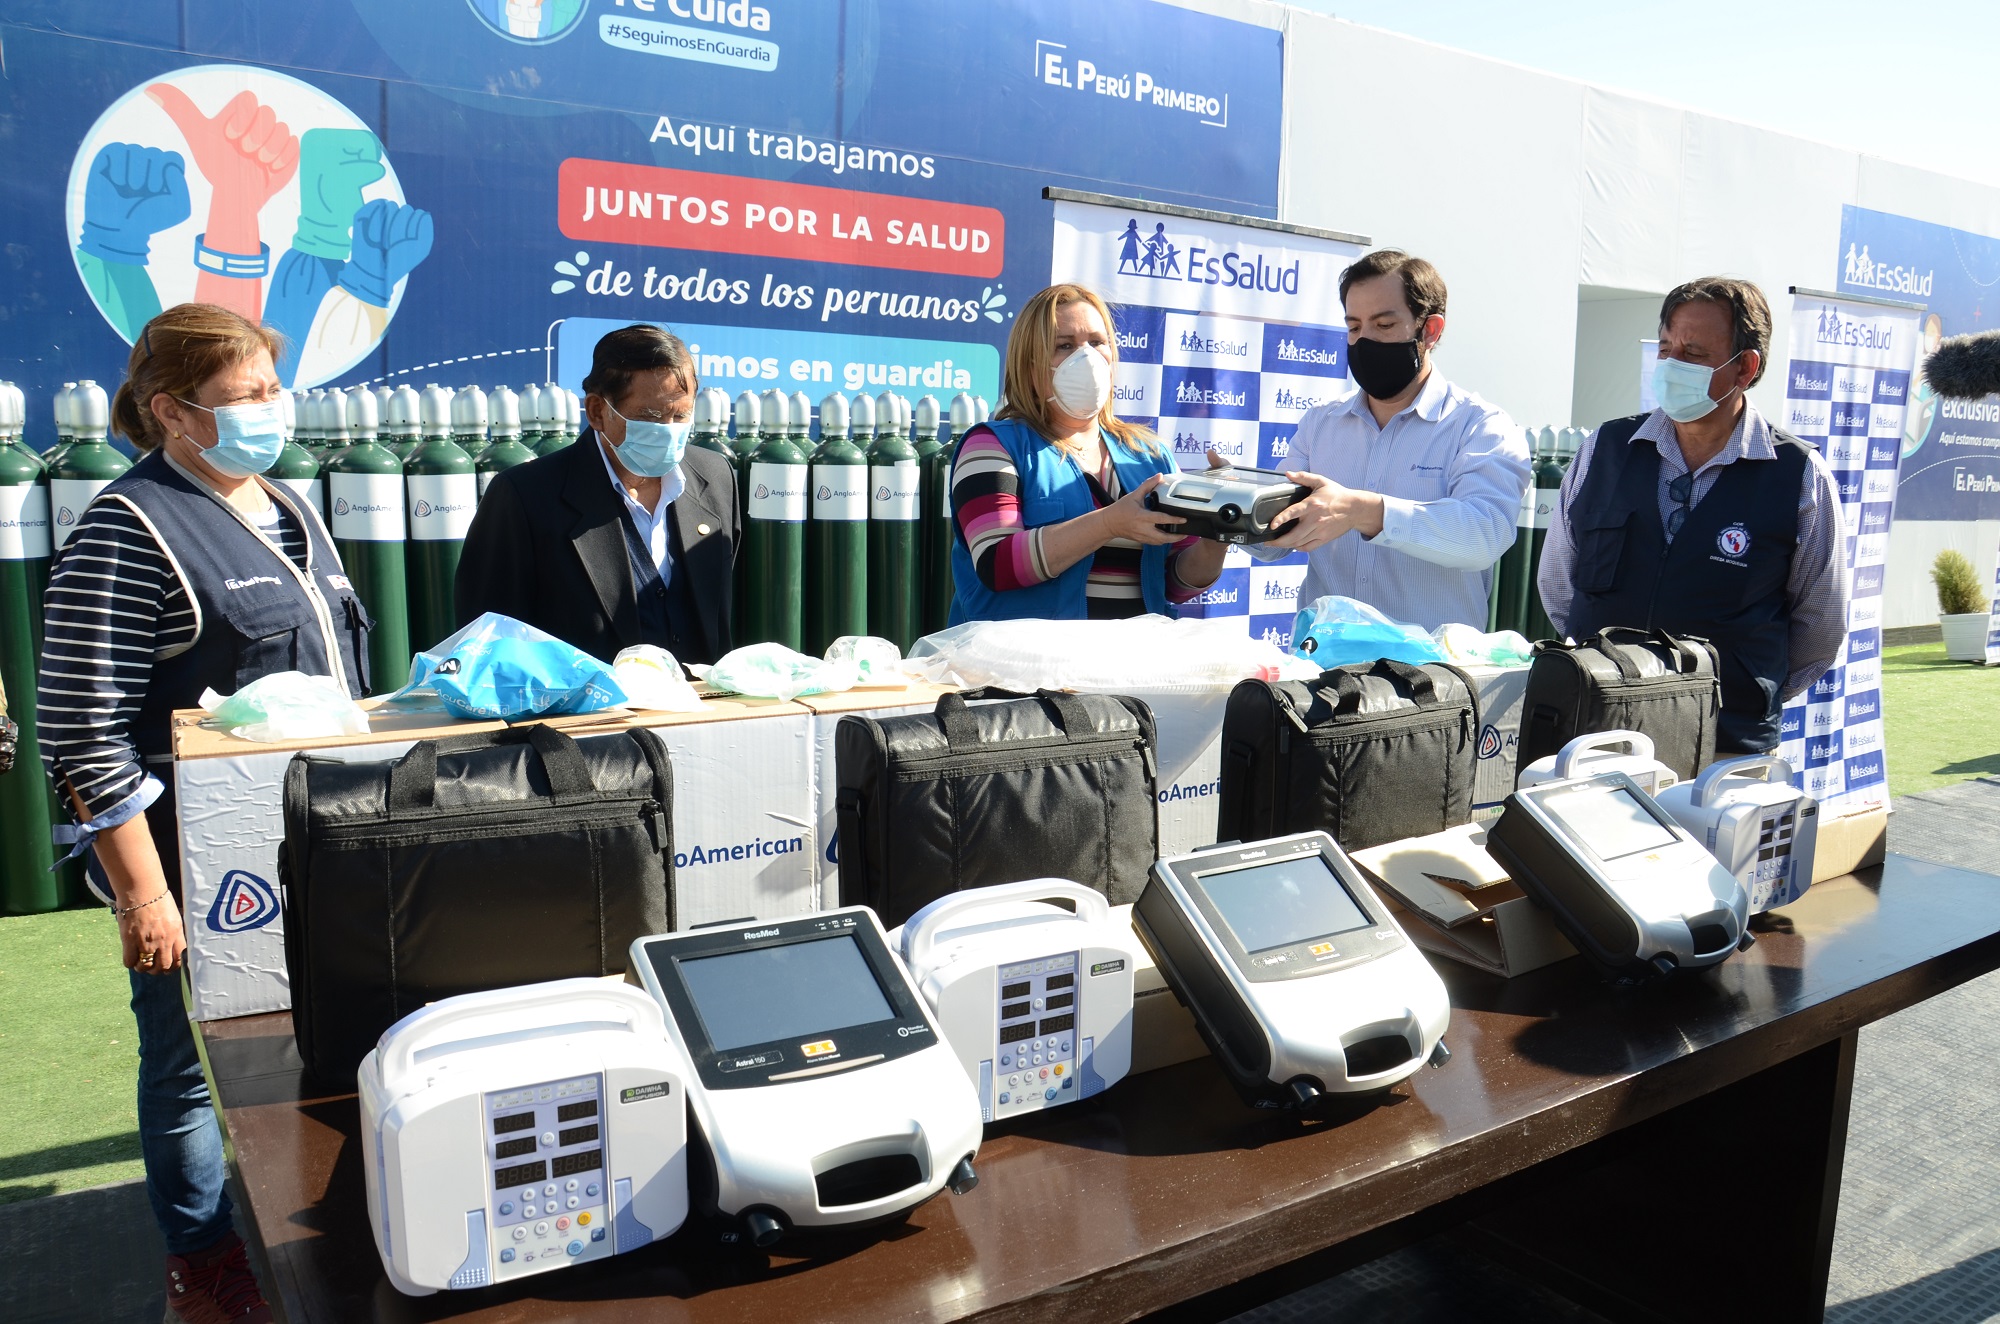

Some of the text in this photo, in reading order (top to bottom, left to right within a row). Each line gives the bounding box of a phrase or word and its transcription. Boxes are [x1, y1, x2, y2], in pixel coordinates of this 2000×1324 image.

[607, 24, 770, 61] #SeguimosEnGuardia
[649, 116, 936, 179] Aquí trabajamos
[583, 186, 990, 254] JUNTOS POR LA SALUD
[1187, 247, 1300, 295] EsSalud
[1876, 262, 1934, 297] EsSalud
[586, 260, 980, 322] de todos los peruanos
[1114, 331, 1148, 349] Salud
[1844, 322, 1892, 350] EsSalud
[1206, 339, 1247, 356] EsSalud
[1299, 348, 1337, 366] EsSalud
[689, 344, 971, 391] imos en guardia
[1112, 385, 1144, 401] Salud
[1807, 380, 1828, 391] EsSalud
[1886, 387, 1903, 397] EsSalud
[1204, 389, 1246, 407] EsSalud
[1803, 415, 1825, 426] EsSalud
[1846, 417, 1865, 428] EsSalud
[1202, 440, 1243, 456] EsSalud
[1939, 431, 2000, 450] Aquí estamos comp
[0, 518, 48, 528] loAmerican
[1200, 587, 1238, 605] EsSalud
[436, 688, 487, 715] AcuCare
[1857, 702, 1875, 715] EsSalud
[1859, 764, 1878, 776] EsSalud
[1158, 777, 1220, 803] oAmeri
[673, 835, 803, 869] oAmerican
[743, 929, 781, 941] ResMed
[736, 1058, 754, 1068] Astral
[623, 1091, 666, 1103] MEDIFUSION
[635, 1085, 662, 1095] DAIWHA
